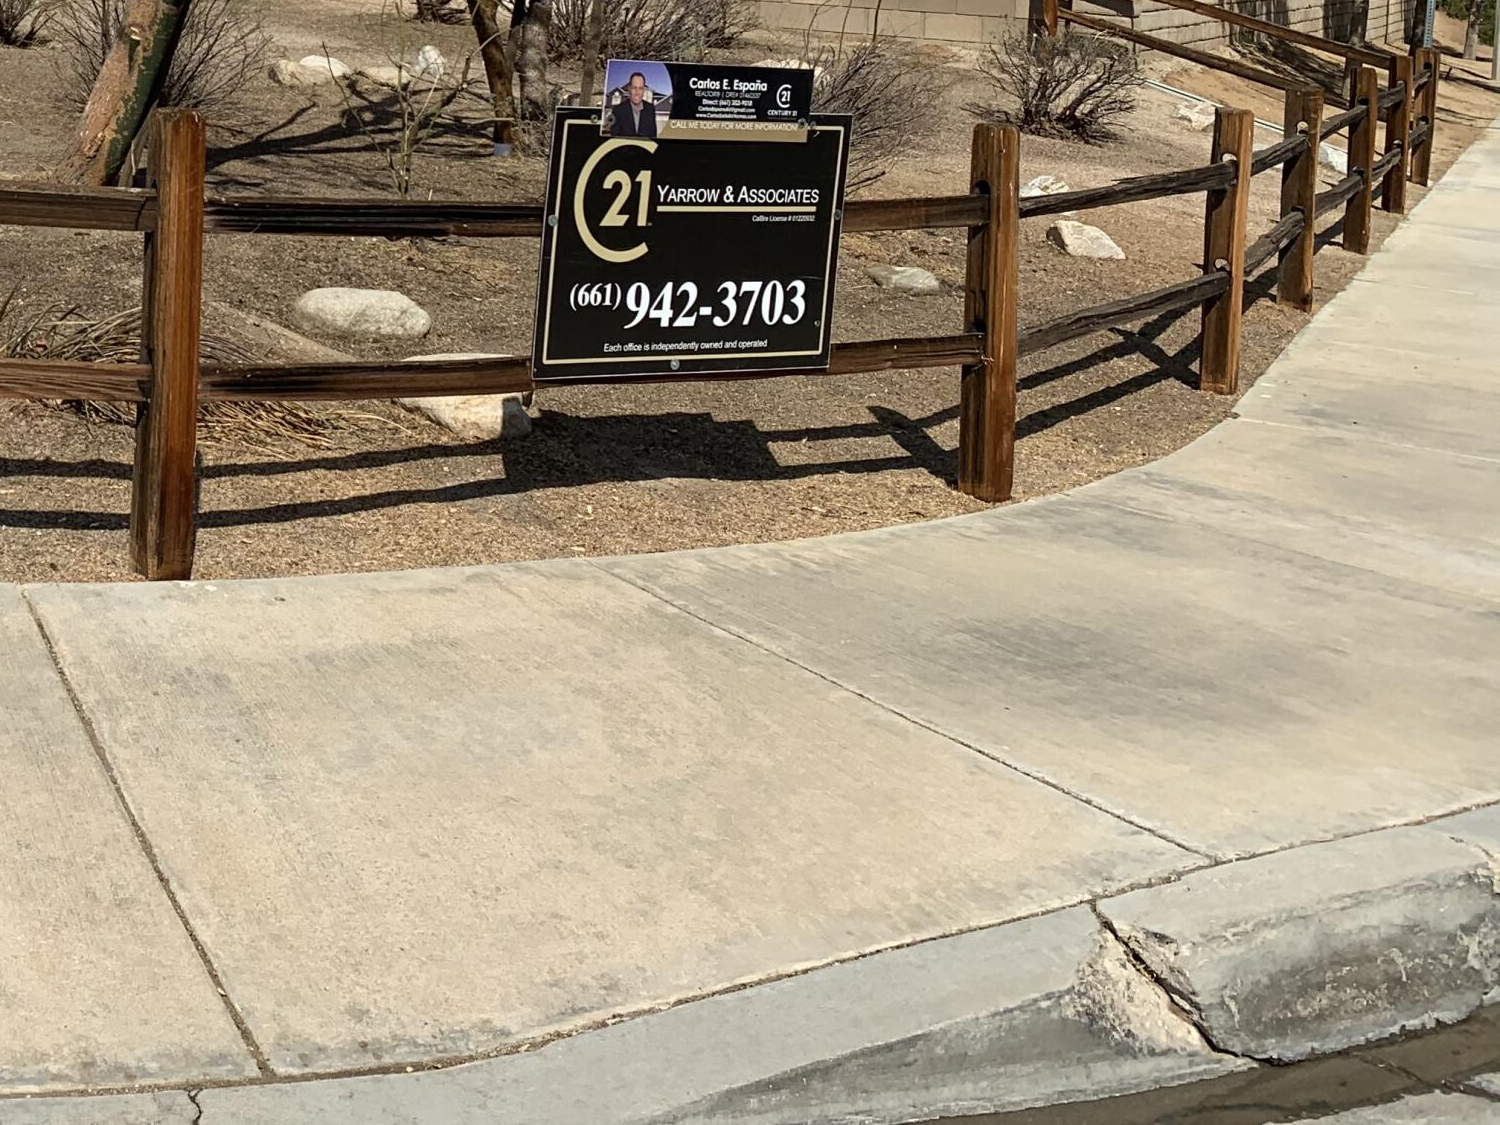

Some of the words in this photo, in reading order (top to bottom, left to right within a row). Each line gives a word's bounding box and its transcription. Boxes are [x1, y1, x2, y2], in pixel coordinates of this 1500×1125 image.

[689, 77, 720, 89] Carlos
[723, 78, 731, 90] E.
[733, 79, 768, 92] España
[670, 120, 687, 129] CALL
[688, 121, 698, 129] ME
[699, 121, 719, 129] TODAY
[721, 122, 734, 130] FOR
[735, 122, 753, 130] MORE
[657, 185, 720, 203] YARROW
[723, 185, 734, 203] &
[737, 185, 820, 203] ASSOCIATES
[569, 282, 622, 311] (661)
[623, 279, 806, 329] 942-3703
[603, 343, 622, 352] Each
[623, 342, 642, 352] office
[643, 342, 650, 351] is
[650, 340, 699, 352] independently
[700, 340, 722, 350] owned
[724, 340, 737, 349] and
[738, 338, 768, 350] operated
